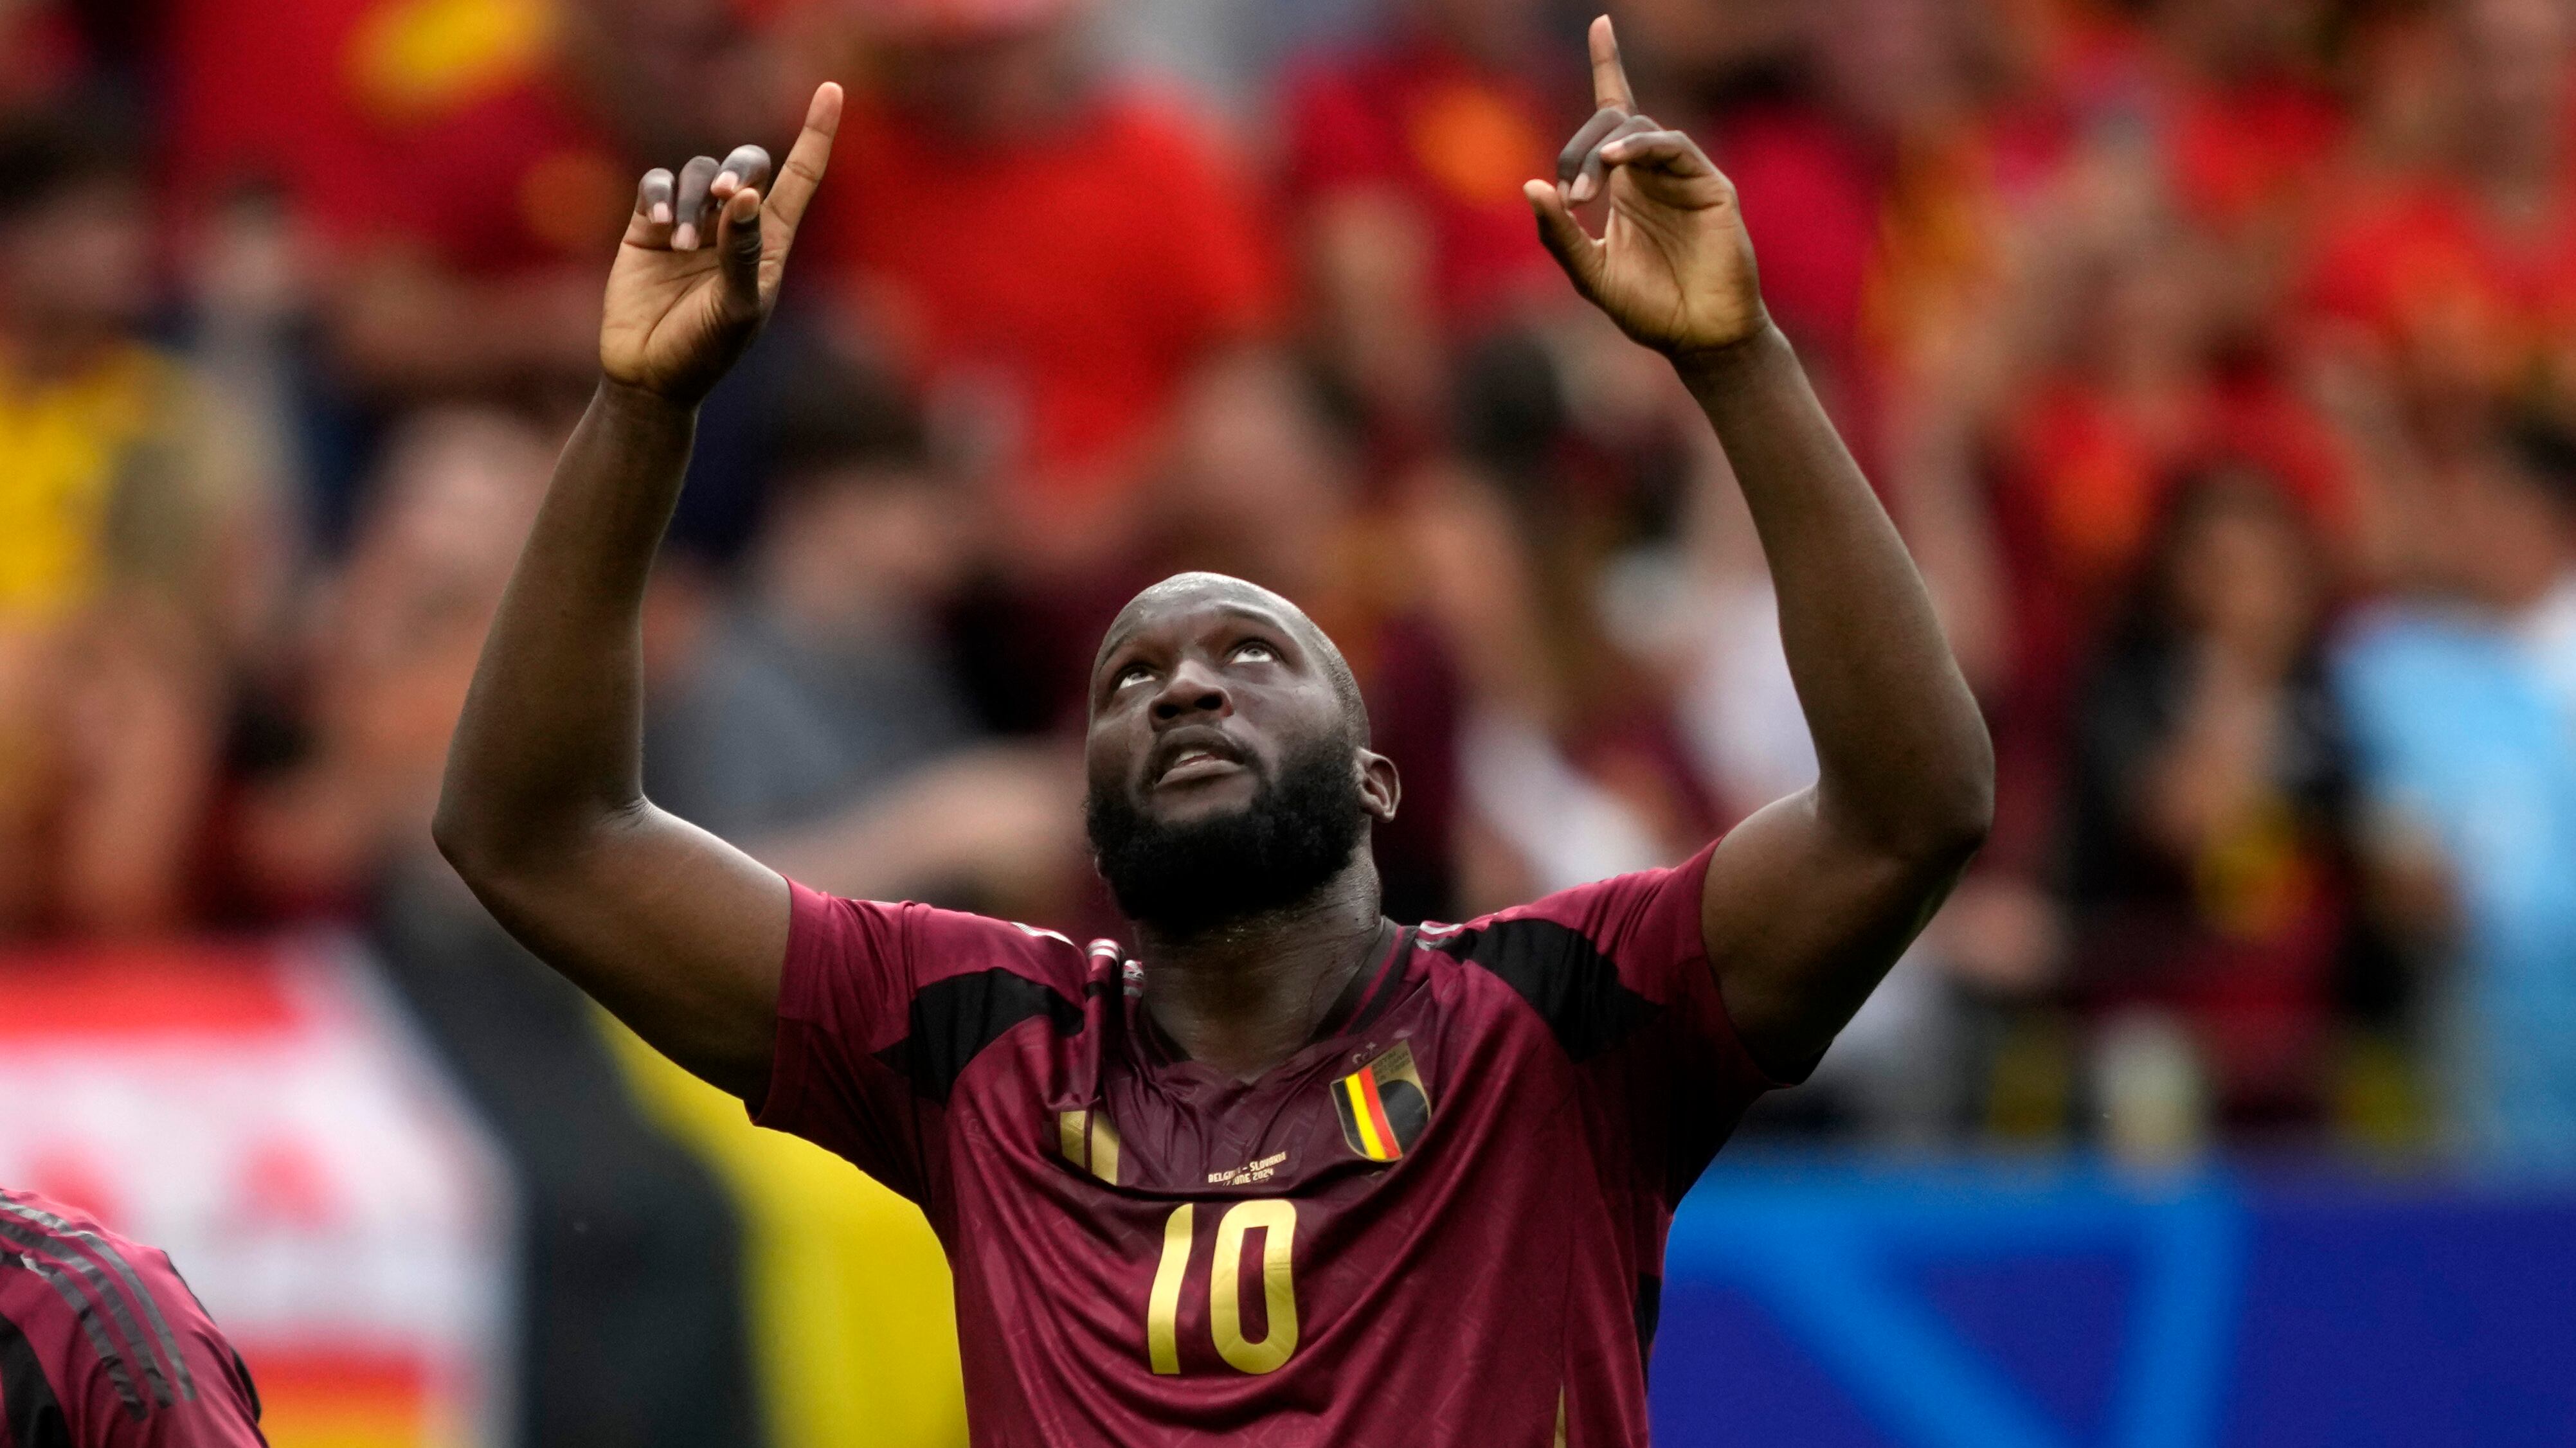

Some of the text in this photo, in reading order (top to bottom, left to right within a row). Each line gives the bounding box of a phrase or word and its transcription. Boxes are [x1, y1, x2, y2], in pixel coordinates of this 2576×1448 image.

[1208, 1167, 1241, 1183] BELGIU
[1249, 1151, 1286, 1172] SLOVAKIA
[1252, 1168, 1274, 1181] 2024
[1148, 1199, 1298, 1374] 10
